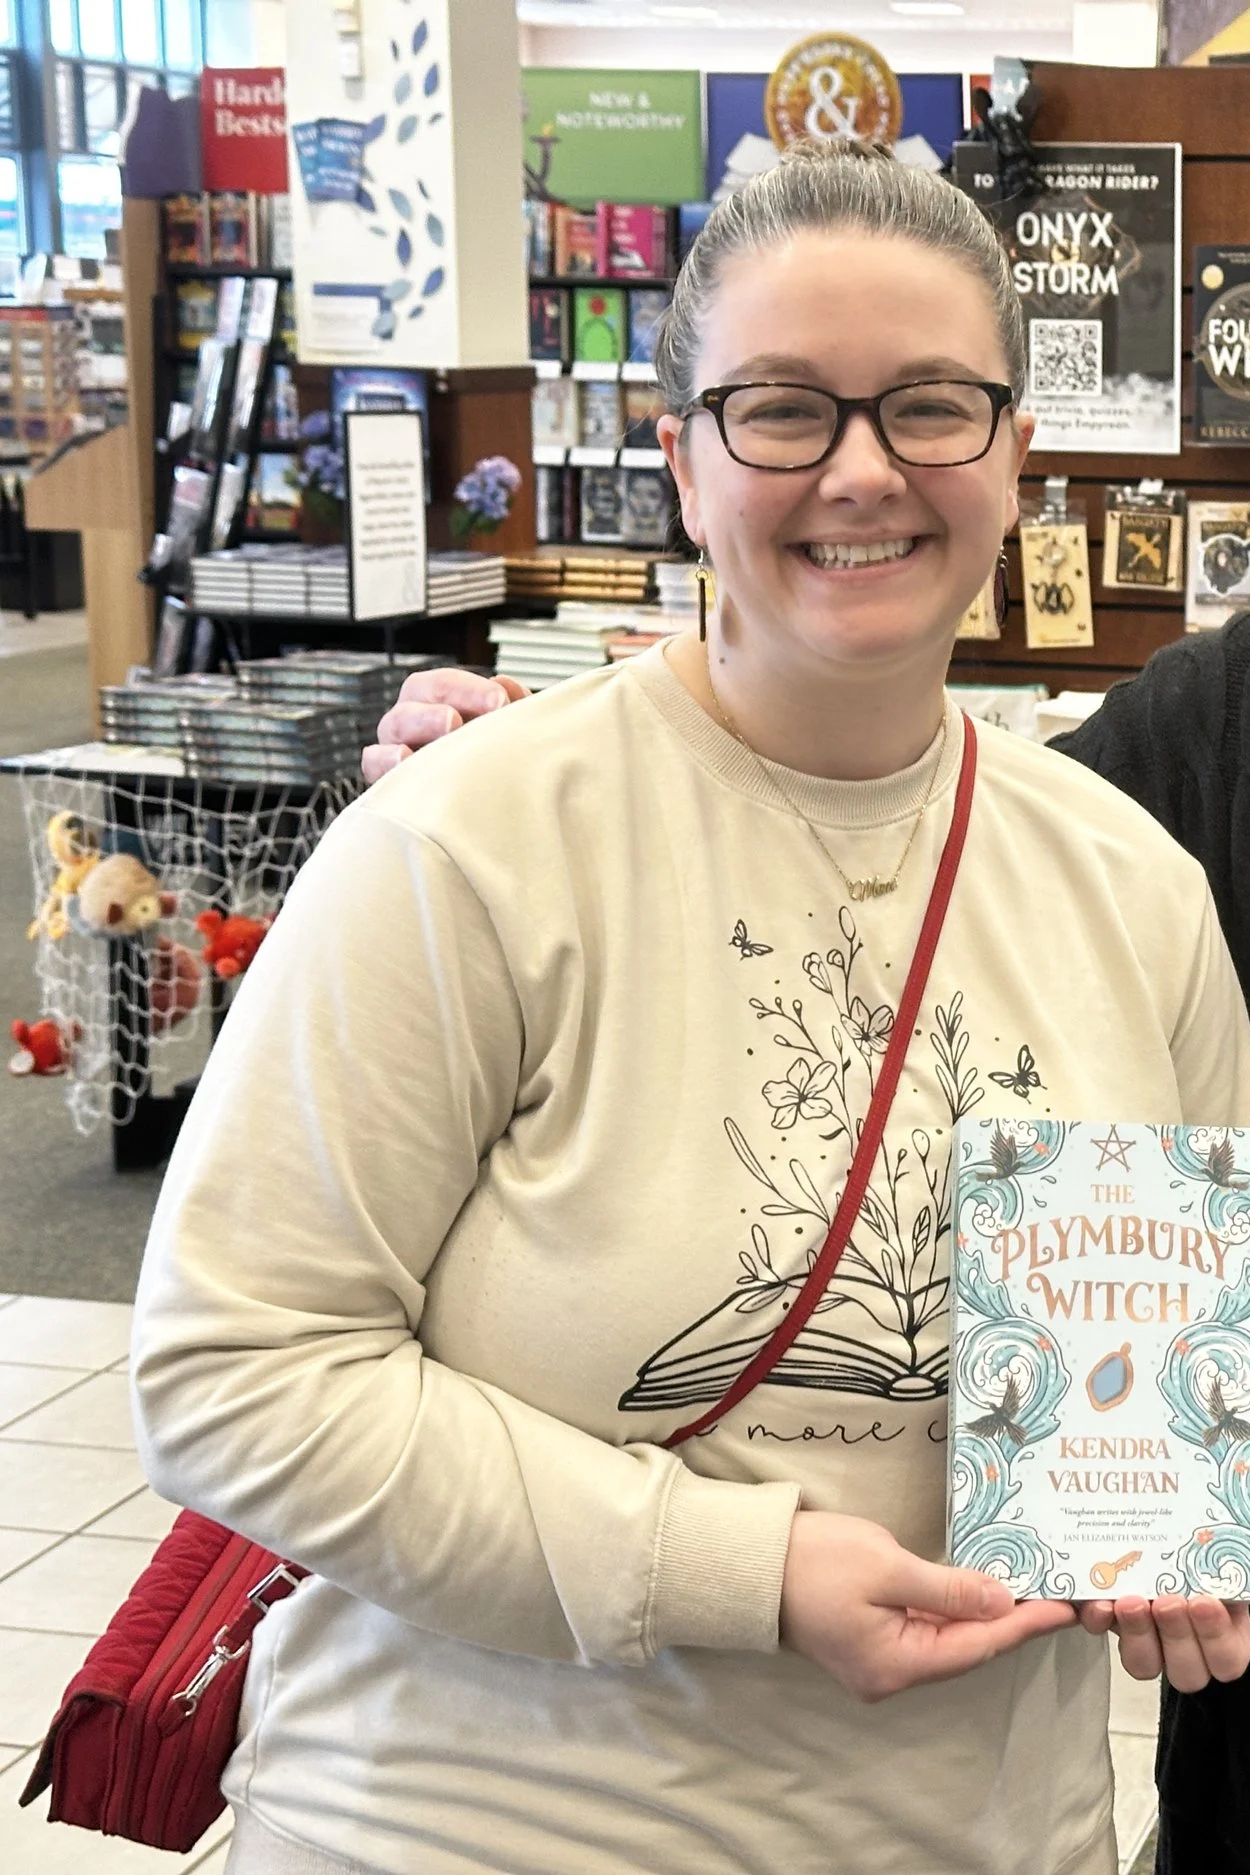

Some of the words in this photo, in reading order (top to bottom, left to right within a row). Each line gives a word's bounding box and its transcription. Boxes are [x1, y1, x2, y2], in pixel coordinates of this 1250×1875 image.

[215, 75, 284, 105] Hard
[589, 91, 632, 108] NEW
[638, 91, 651, 109] &
[556, 111, 686, 130] NOTEWORTHY
[1064, 163, 1094, 174] WHAT
[974, 174, 995, 189] TO
[1045, 174, 1102, 190] RAGON
[1105, 175, 1159, 191] RIDER?
[1016, 212, 1114, 249] ONYX
[1014, 261, 1120, 296] STORM
[1090, 1183, 1136, 1204] THE
[990, 1214, 1231, 1282] PLYMBURY
[1026, 1271, 1191, 1324] WITCH
[747, 1420, 906, 1444] more
[1058, 1436, 1172, 1460] KENDRA
[1047, 1470, 1181, 1494] VAUGHAN
[1097, 1508, 1119, 1516] writes
[1121, 1507, 1137, 1516] with
[1077, 1519, 1110, 1529] precision
[1111, 1518, 1126, 1527] and
[1063, 1533, 1080, 1543] JAN
[1081, 1533, 1130, 1543] ELIZABETH
[1131, 1533, 1168, 1543] WATSON
